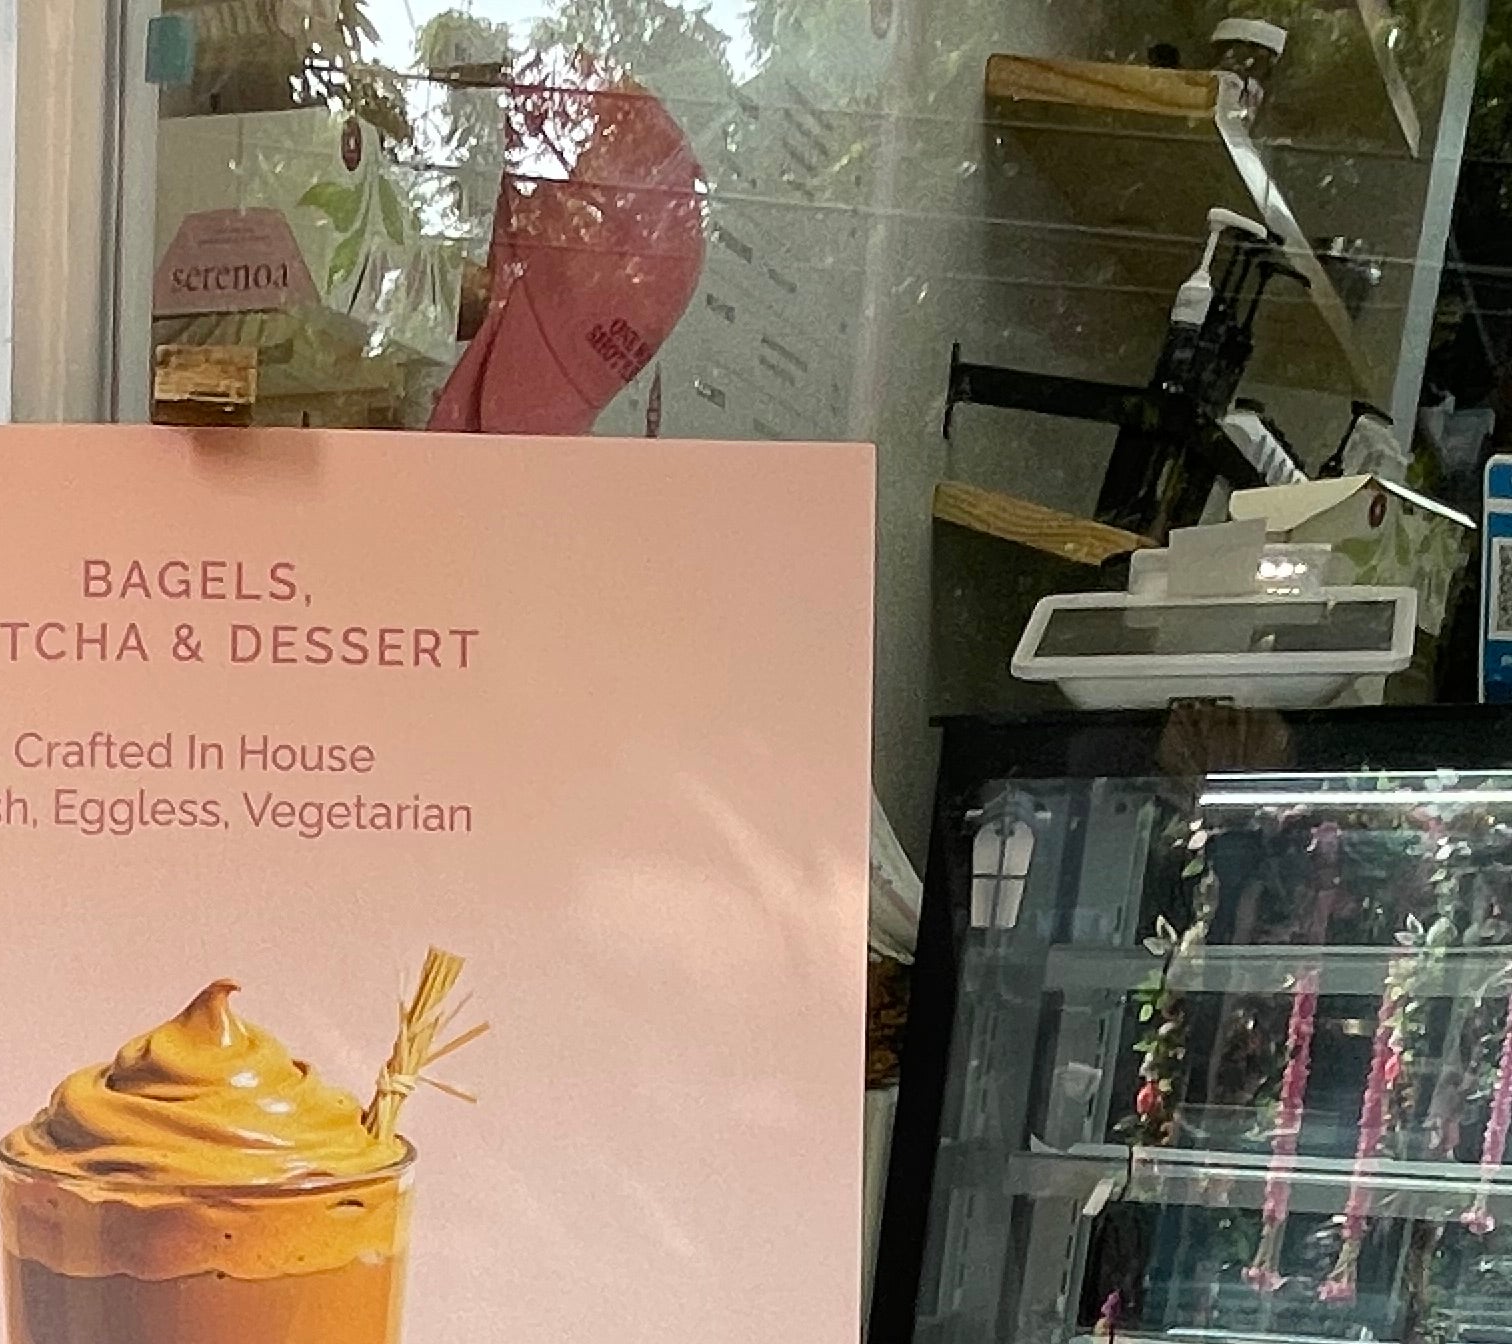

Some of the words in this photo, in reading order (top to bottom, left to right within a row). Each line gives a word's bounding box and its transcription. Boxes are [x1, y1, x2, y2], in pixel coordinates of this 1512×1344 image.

[171, 263, 289, 293] serenoa
[82, 558, 313, 607] BAGELS,
[171, 622, 205, 664] &
[229, 624, 481, 669] DESSERT
[14, 730, 173, 770] Crafted
[188, 733, 224, 771] In
[239, 733, 376, 774] House
[53, 787, 230, 837] Eggless,
[242, 791, 473, 840] Vegetarian
